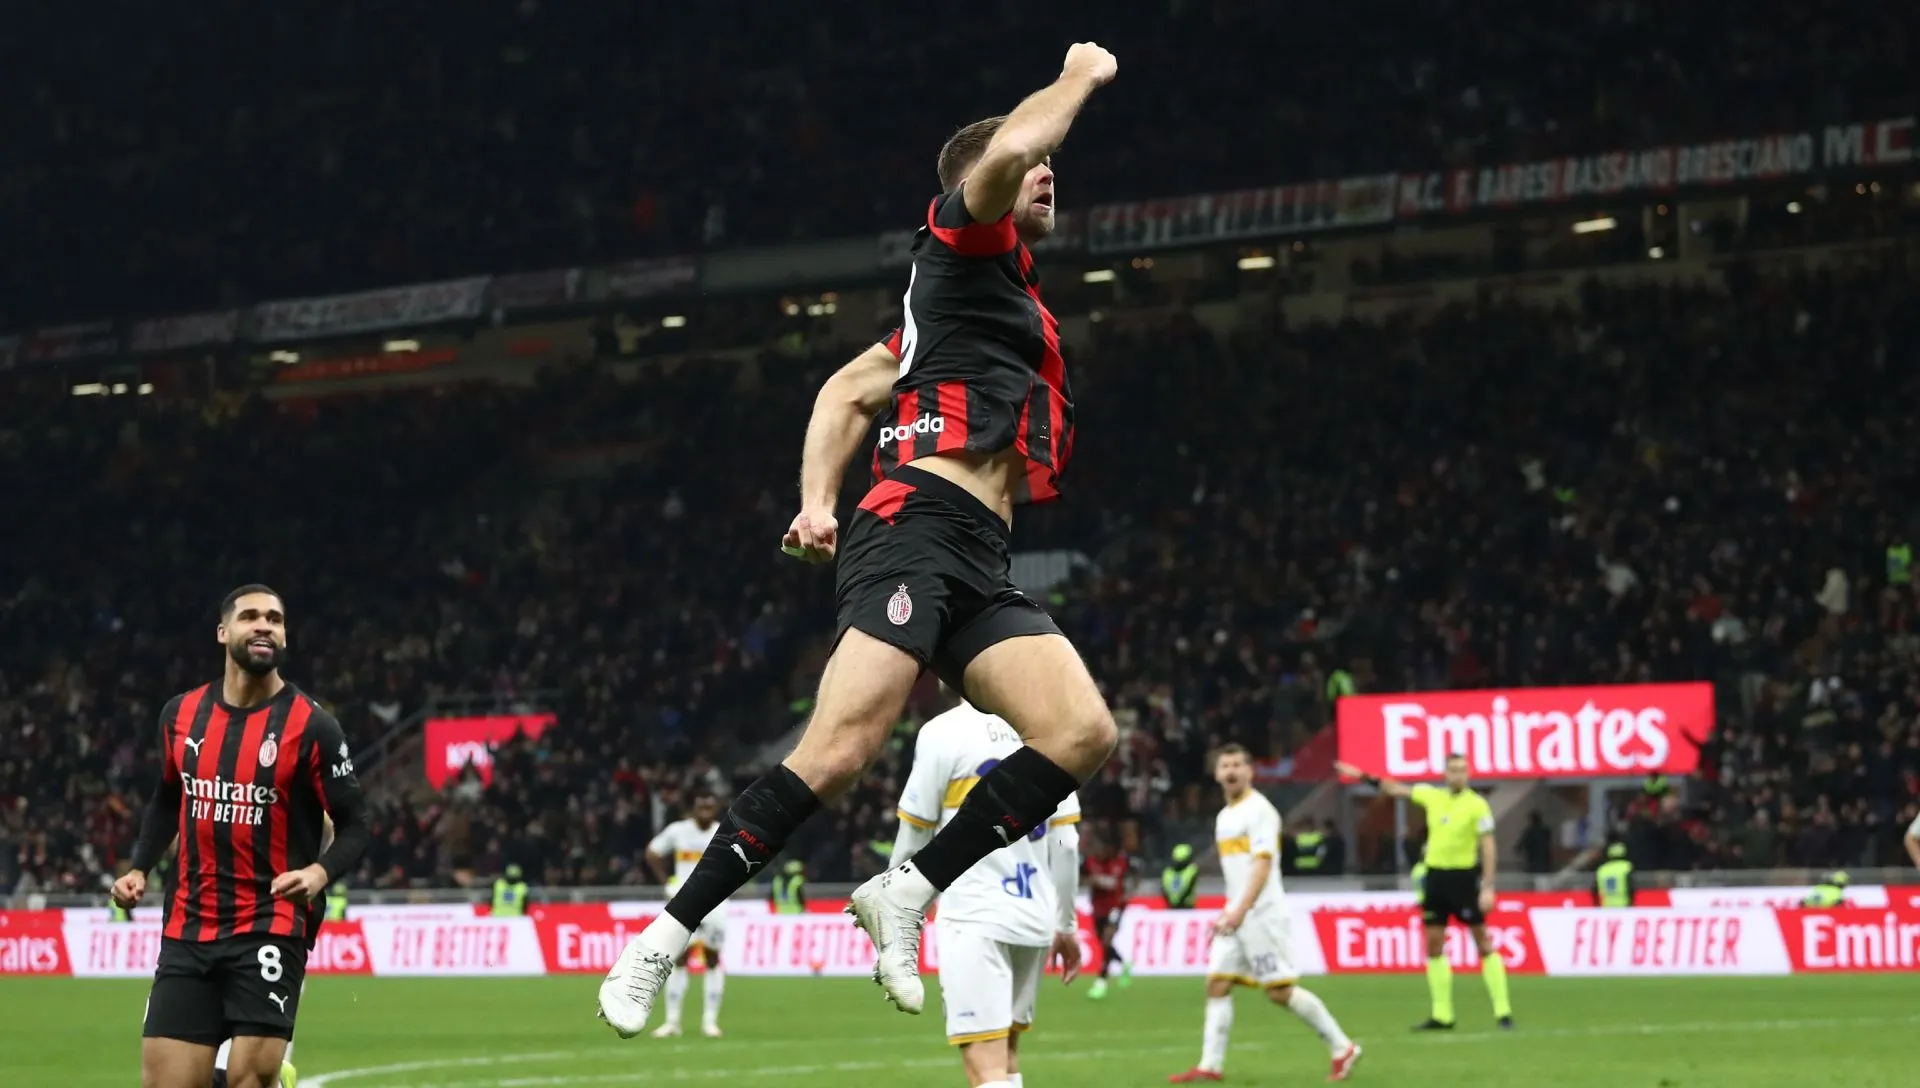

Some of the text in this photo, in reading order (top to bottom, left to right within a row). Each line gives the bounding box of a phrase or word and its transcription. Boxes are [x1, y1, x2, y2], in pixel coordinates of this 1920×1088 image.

[1381, 695, 1669, 776] Emirates
[180, 771, 279, 805] Emirates
[191, 799, 264, 826] FLY BETTER
[88, 930, 122, 969] FLY
[391, 925, 511, 968] FLY BETTER
[743, 923, 783, 967] FLY
[1131, 919, 1174, 966] FLY
[1571, 917, 1741, 966] FLY BETTER
[257, 944, 283, 983] 8
